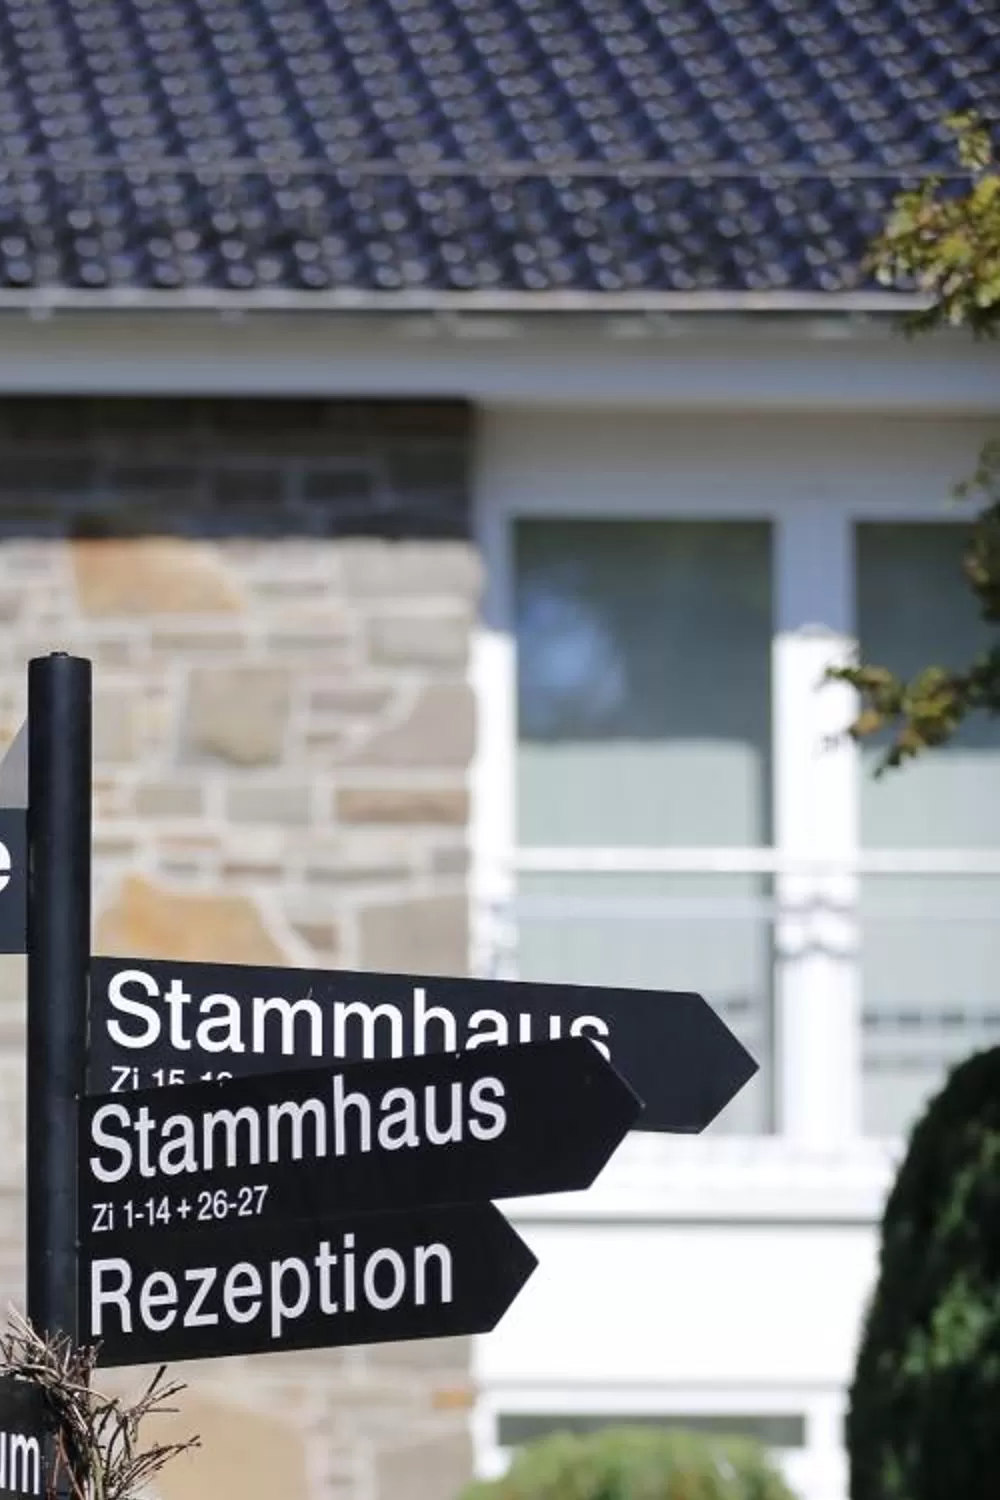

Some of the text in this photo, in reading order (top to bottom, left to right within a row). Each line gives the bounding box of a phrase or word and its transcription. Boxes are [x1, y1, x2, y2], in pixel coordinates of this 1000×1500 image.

[110, 1065, 139, 1092] Zi
[89, 1074, 507, 1183] Stammhaus
[91, 1185, 269, 1233] Zi 1-14 + 26-27
[91, 1233, 452, 1338] Rezeption
